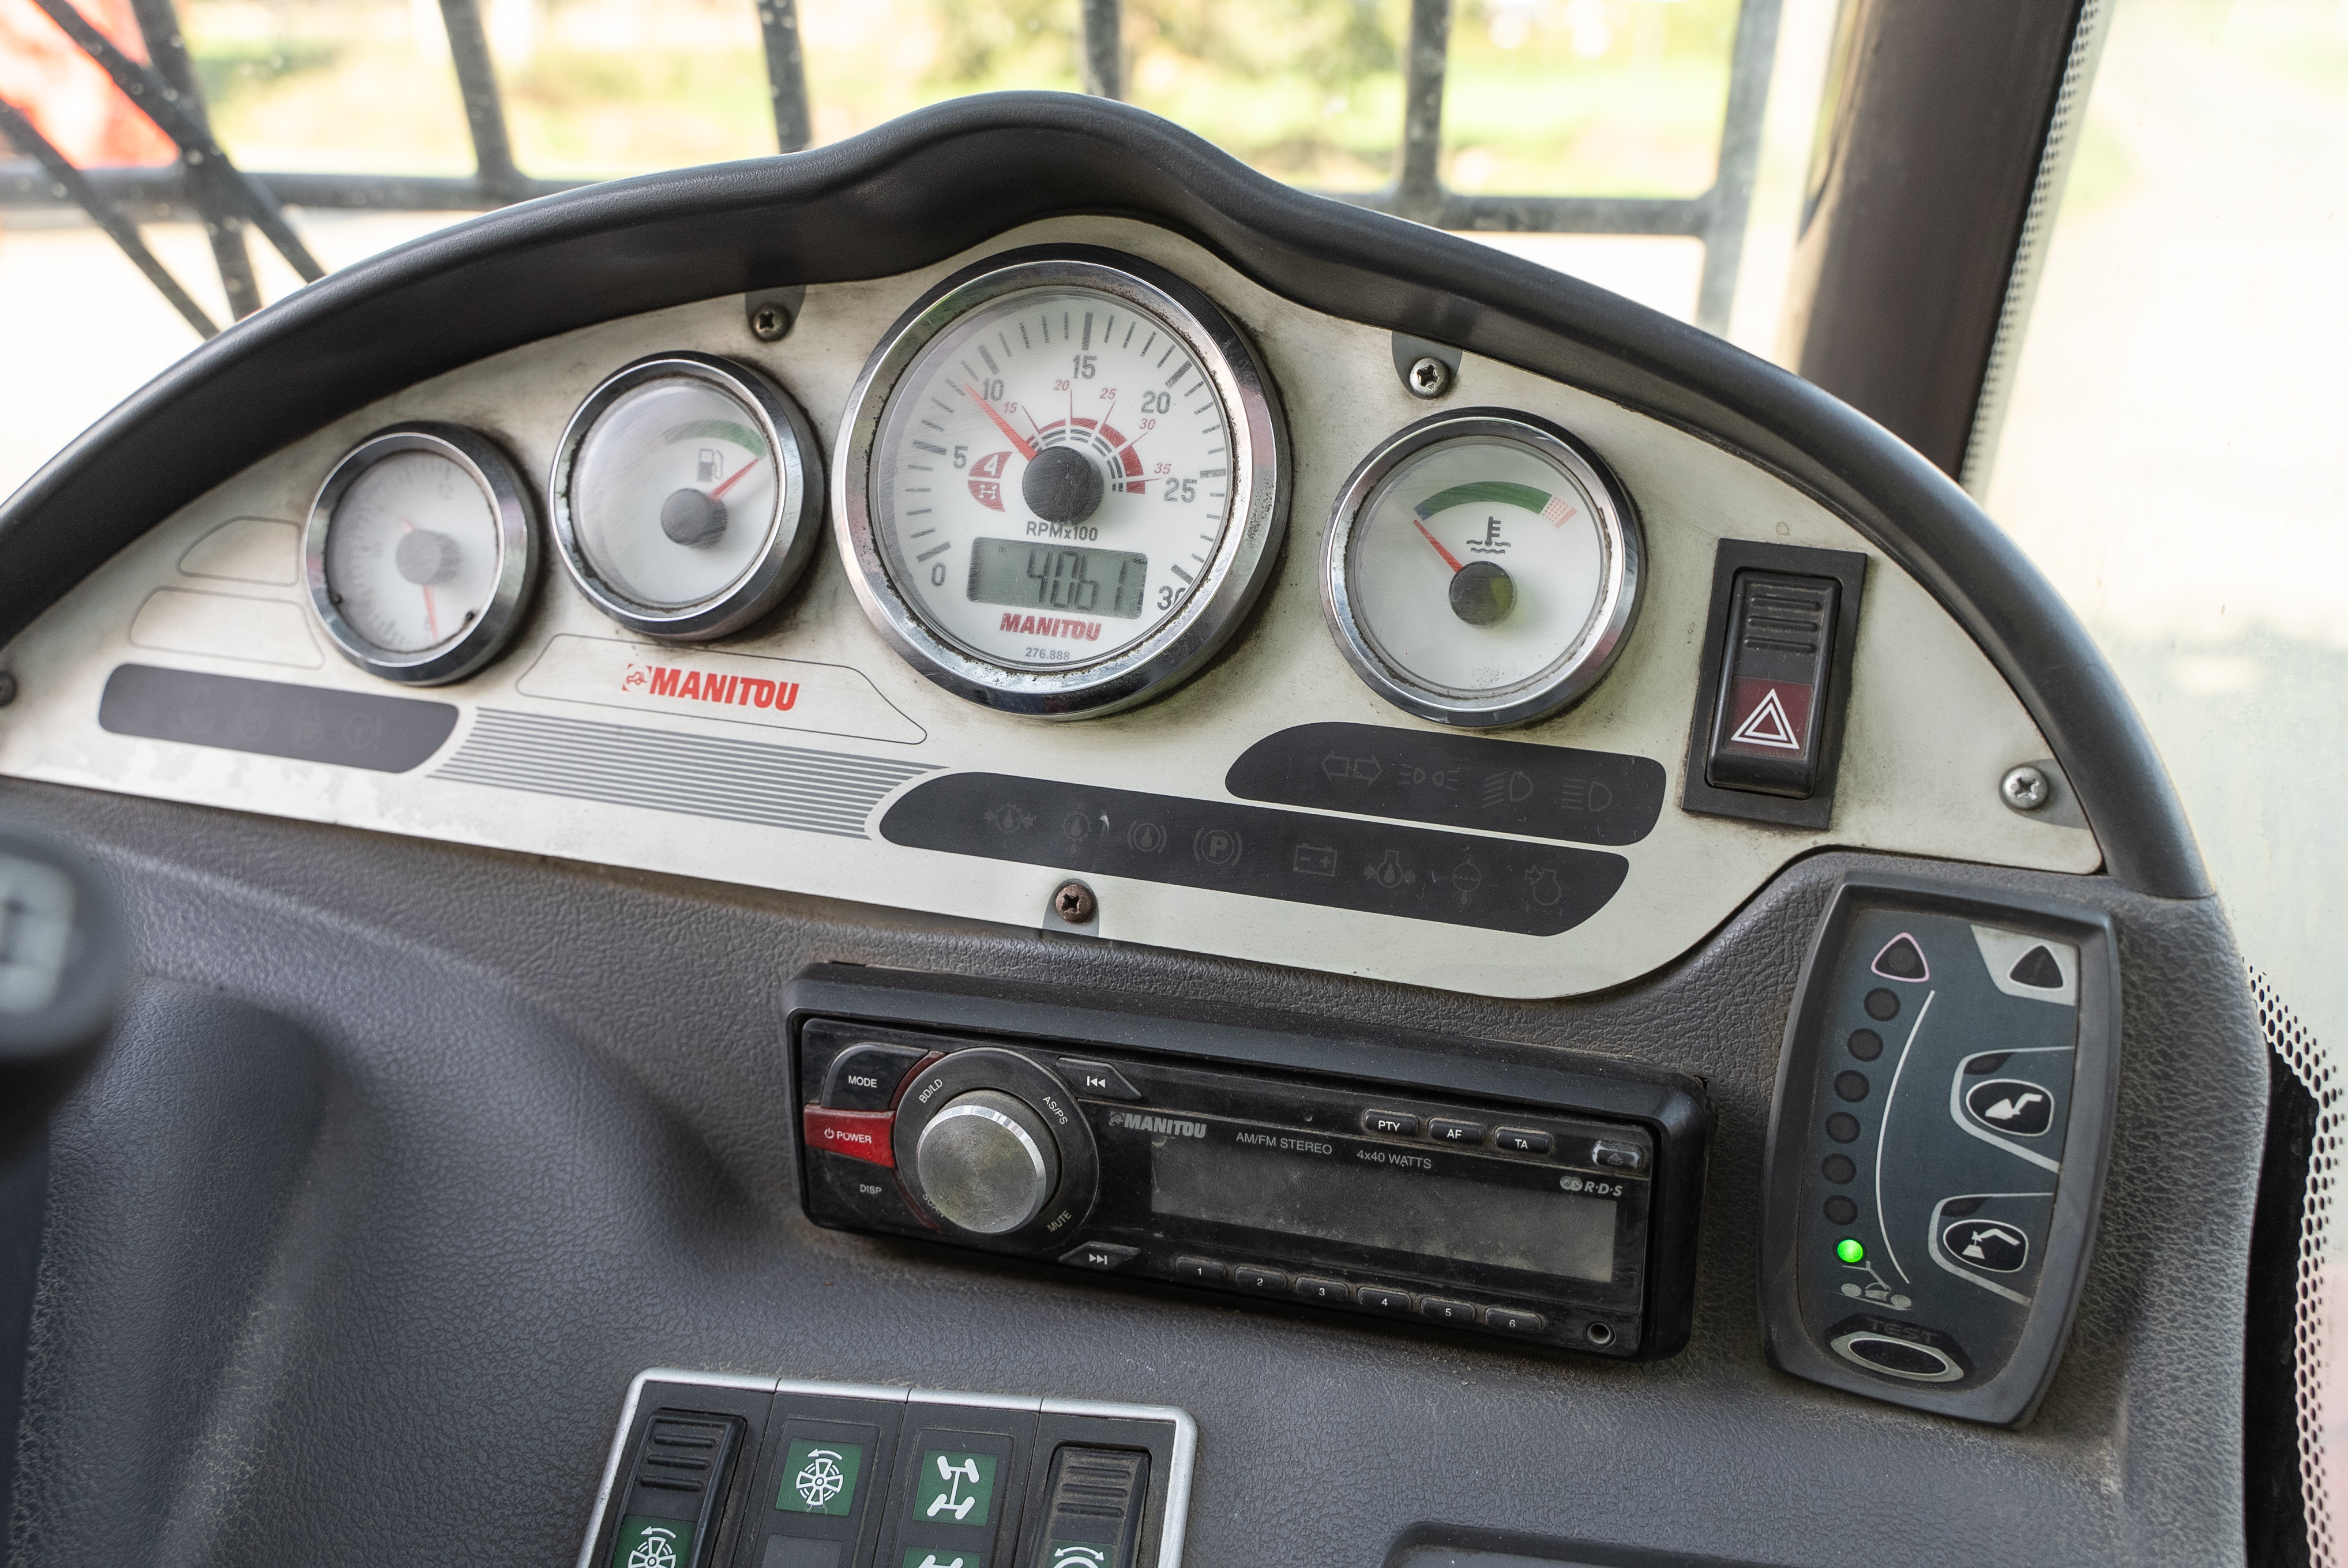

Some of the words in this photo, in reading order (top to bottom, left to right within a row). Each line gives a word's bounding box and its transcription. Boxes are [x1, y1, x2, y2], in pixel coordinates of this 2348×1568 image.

[1073, 354, 1098, 379] 15
[983, 378, 1004, 401] 10
[1053, 379, 1070, 391] 20
[1099, 388, 1117, 400] 25
[1004, 401, 1018, 413] 15
[1140, 390, 1171, 414] 20
[1139, 418, 1156, 430] 30
[953, 445, 969, 469] 5
[1154, 463, 1171, 475] 35
[1163, 477, 1197, 503] 25
[1025, 521, 1098, 541] RPMx100
[931, 562, 946, 587] 0
[1026, 548, 1126, 611] 4061
[1000, 612, 1102, 641] MANITOU
[1025, 646, 1070, 661] 276.888
[649, 667, 799, 711] MANITOU
[848, 1075, 877, 1088] MODE
[918, 1078, 943, 1103] BD/LD
[1042, 1096, 1068, 1125] AS/PS
[1124, 1113, 1207, 1138] MANITOU
[1378, 1120, 1400, 1131] PTY
[836, 1130, 872, 1144] POWER
[1447, 1129, 1463, 1140] AF
[1236, 1131, 1276, 1147] AM/FM
[1280, 1138, 1332, 1155] STEREO
[1515, 1138, 1528, 1149] TA
[1357, 1149, 1385, 1163] 4x40
[1388, 1153, 1432, 1170] WATTS
[859, 1184, 882, 1195] DISP
[1047, 1210, 1072, 1232] MUTE
[1197, 1267, 1202, 1276] 1
[1256, 1277, 1264, 1287] 2
[1318, 1287, 1325, 1296] 3
[1381, 1298, 1388, 1306] 4
[1445, 1308, 1452, 1317] 5
[1509, 1319, 1516, 1328] 6
[1867, 1318, 1939, 1343] TEST
